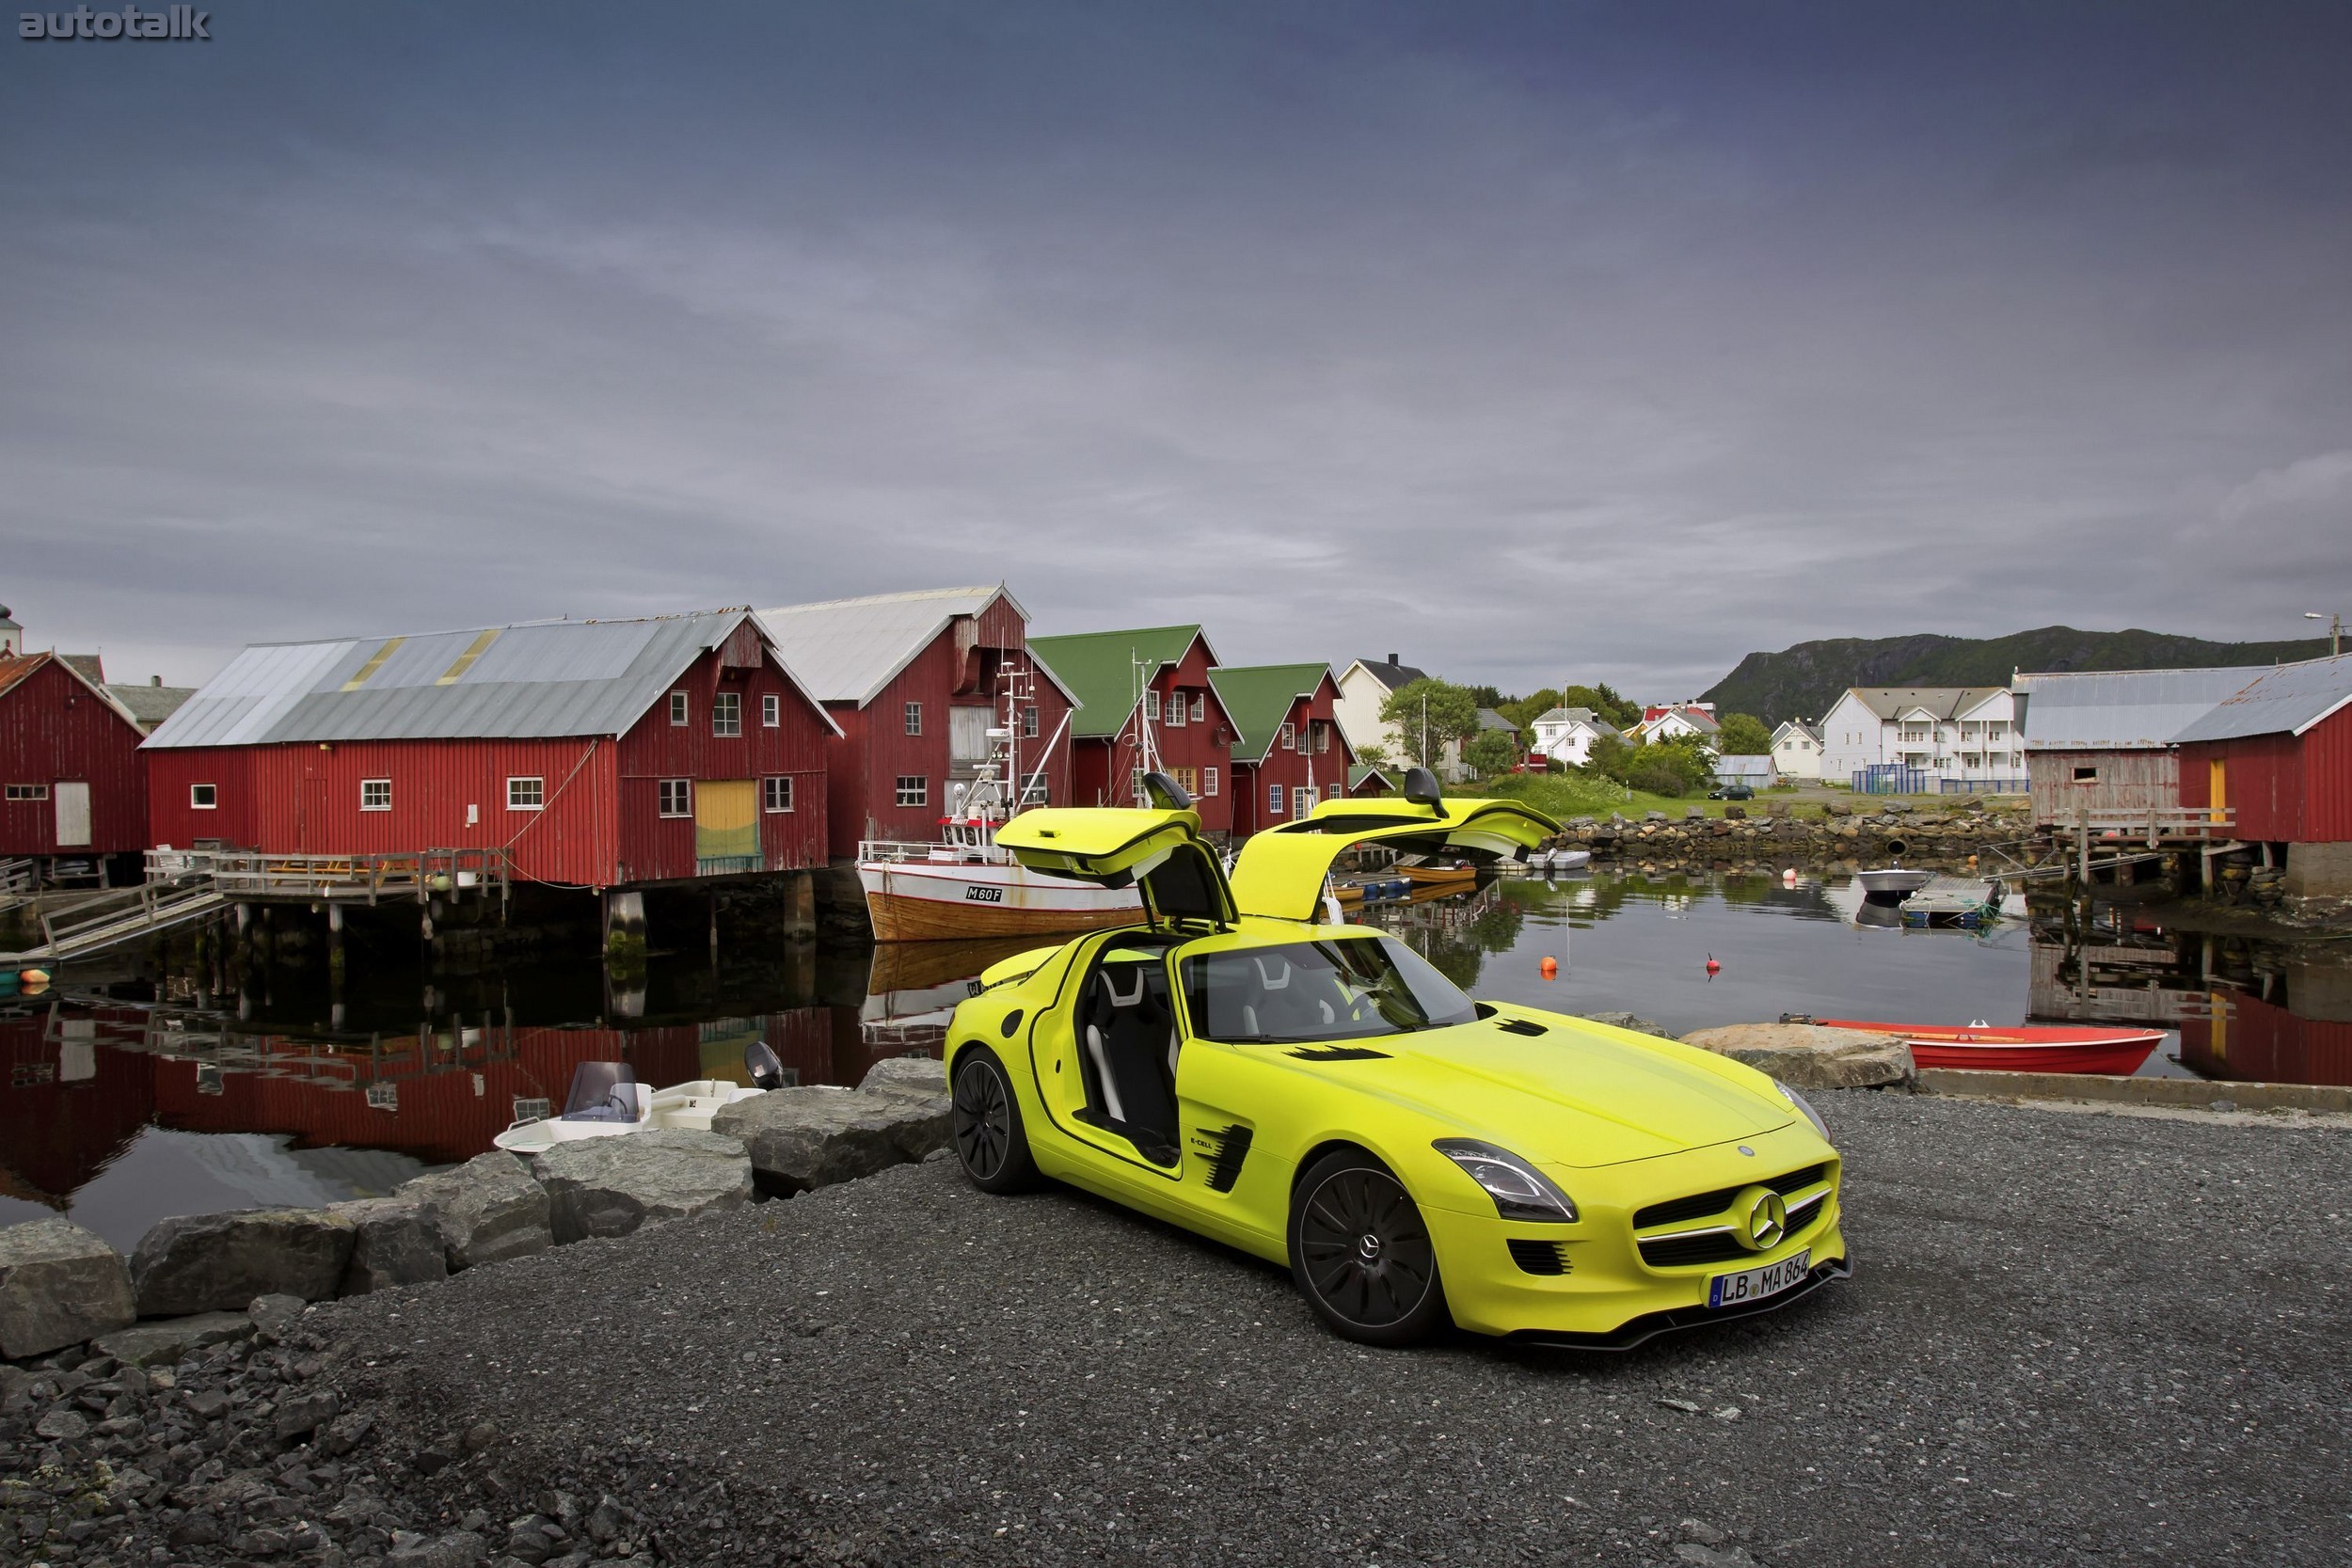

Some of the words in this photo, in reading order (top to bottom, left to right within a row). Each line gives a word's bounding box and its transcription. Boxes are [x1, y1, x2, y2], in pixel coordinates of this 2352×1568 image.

[1190, 1137, 1213, 1149] E-CELL
[1722, 1275, 1748, 1302] LB
[1760, 1266, 1781, 1294] MA
[1784, 1253, 1809, 1284] 864
